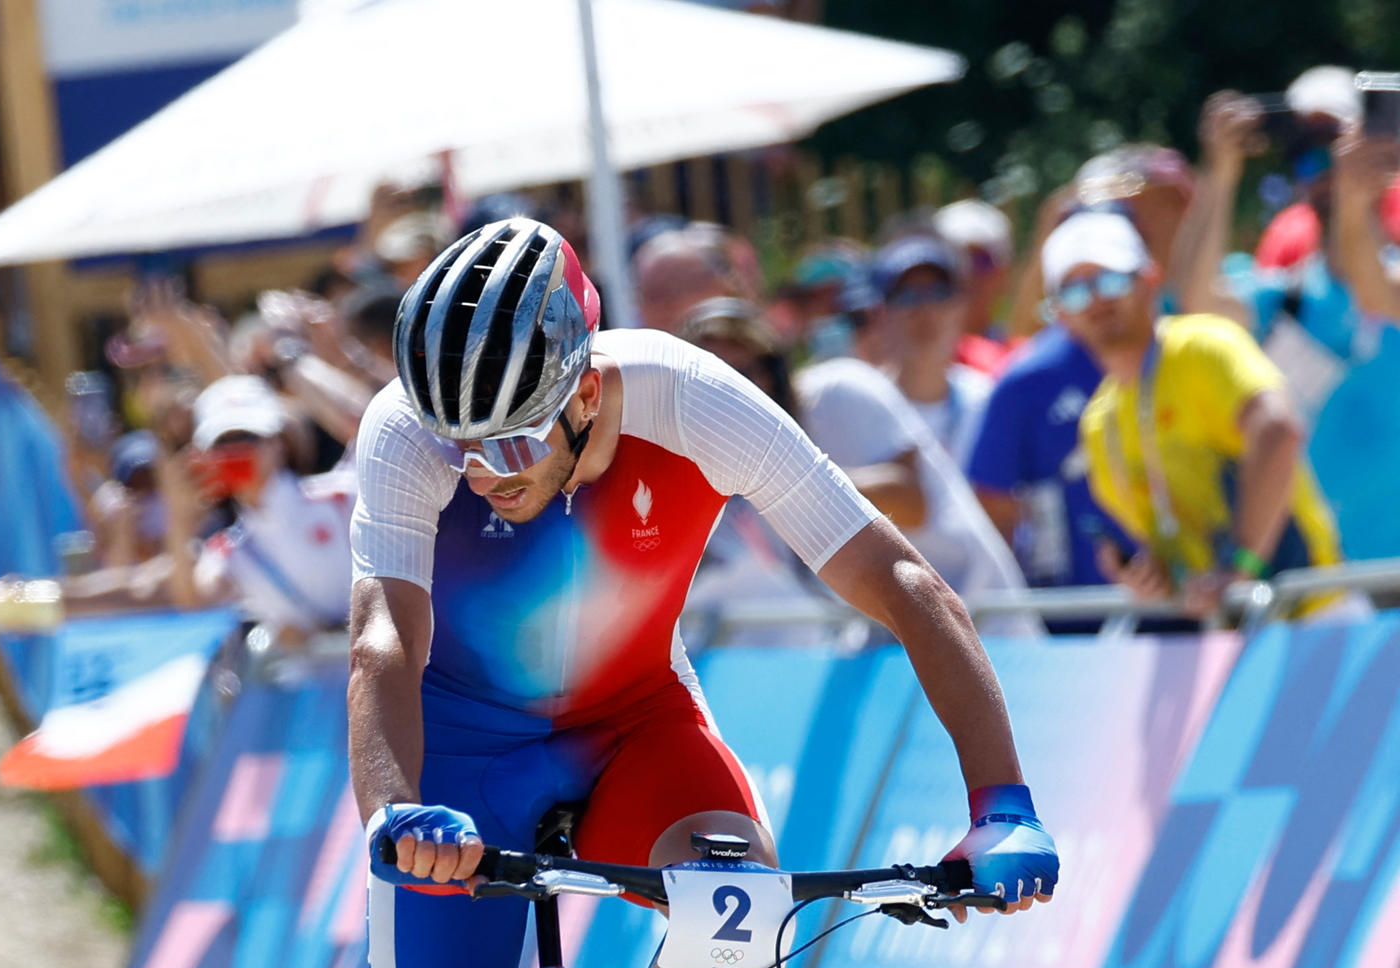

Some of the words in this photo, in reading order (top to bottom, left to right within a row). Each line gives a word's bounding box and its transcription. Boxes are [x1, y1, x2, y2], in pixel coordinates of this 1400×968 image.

[631, 525, 660, 539] FRANCE
[711, 849, 747, 858] wahoo
[682, 861, 724, 869] PARIS
[712, 885, 753, 943] 2
